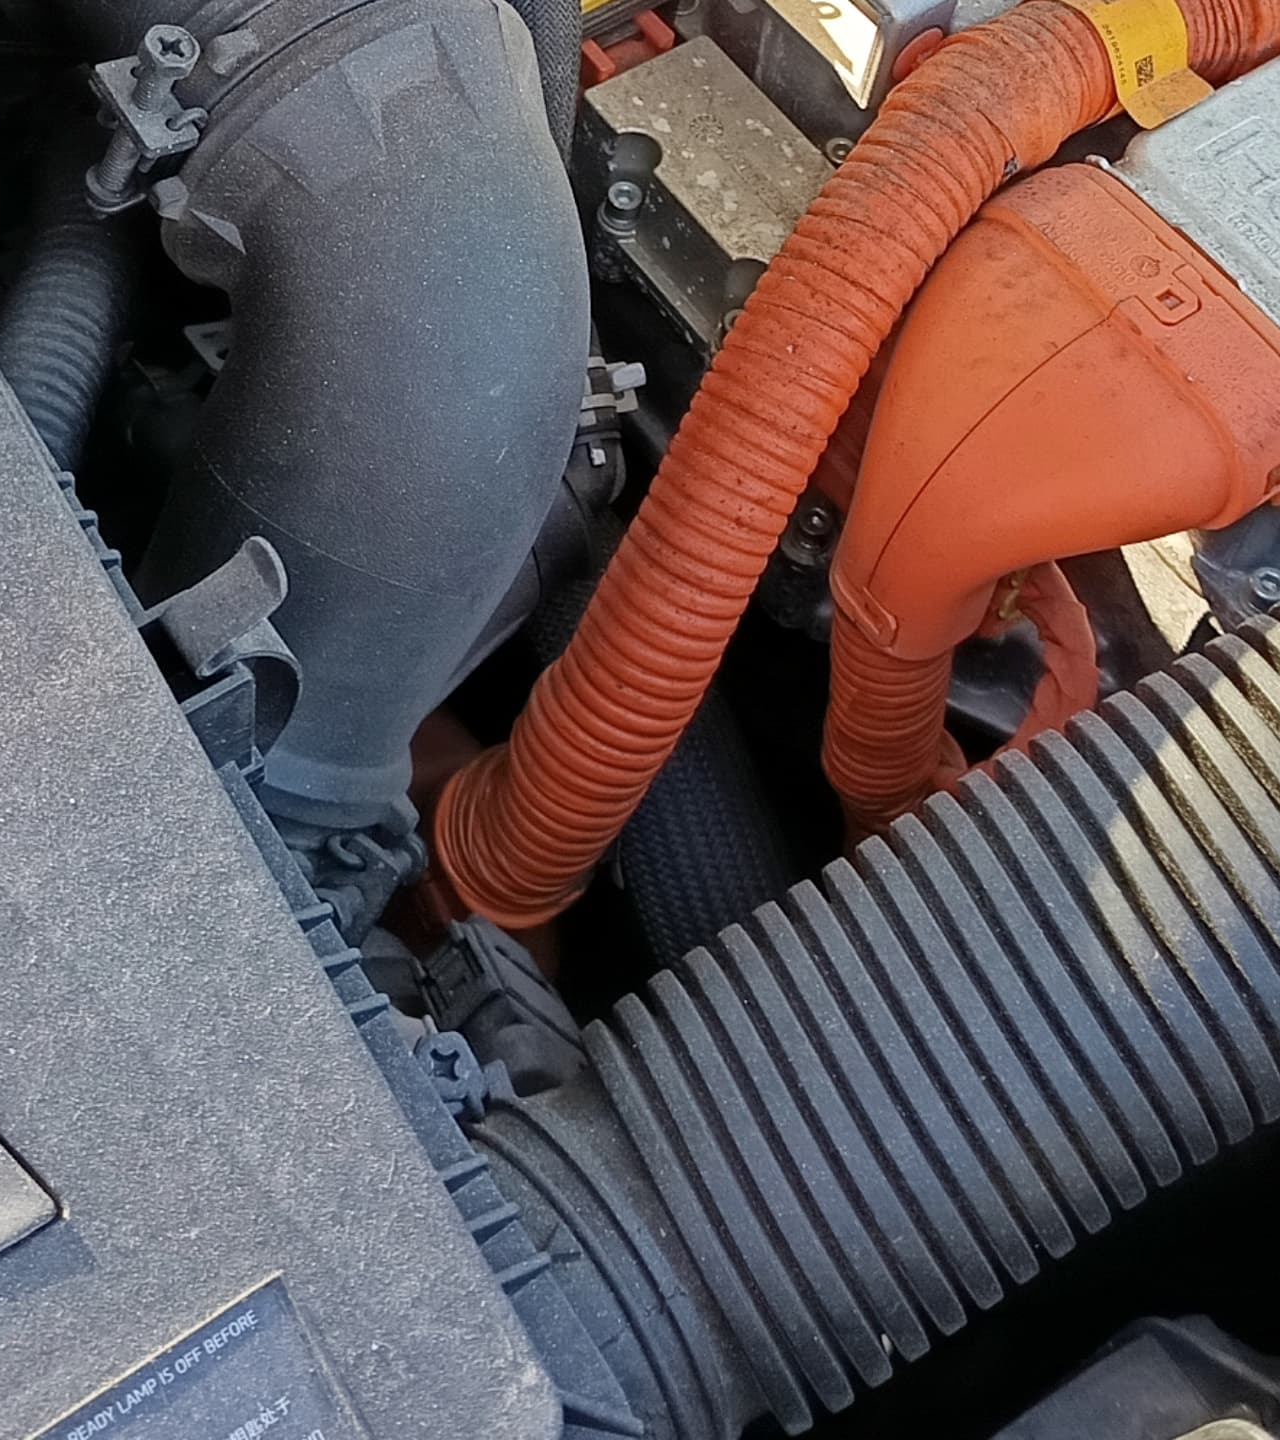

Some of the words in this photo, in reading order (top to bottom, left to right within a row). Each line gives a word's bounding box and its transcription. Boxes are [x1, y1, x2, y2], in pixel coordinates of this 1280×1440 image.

[67, 1405, 115, 1440] READY
[117, 1377, 158, 1414] LAMP
[158, 1368, 175, 1387] IS
[174, 1346, 204, 1375] OFF
[202, 1309, 259, 1355] BEFORE
